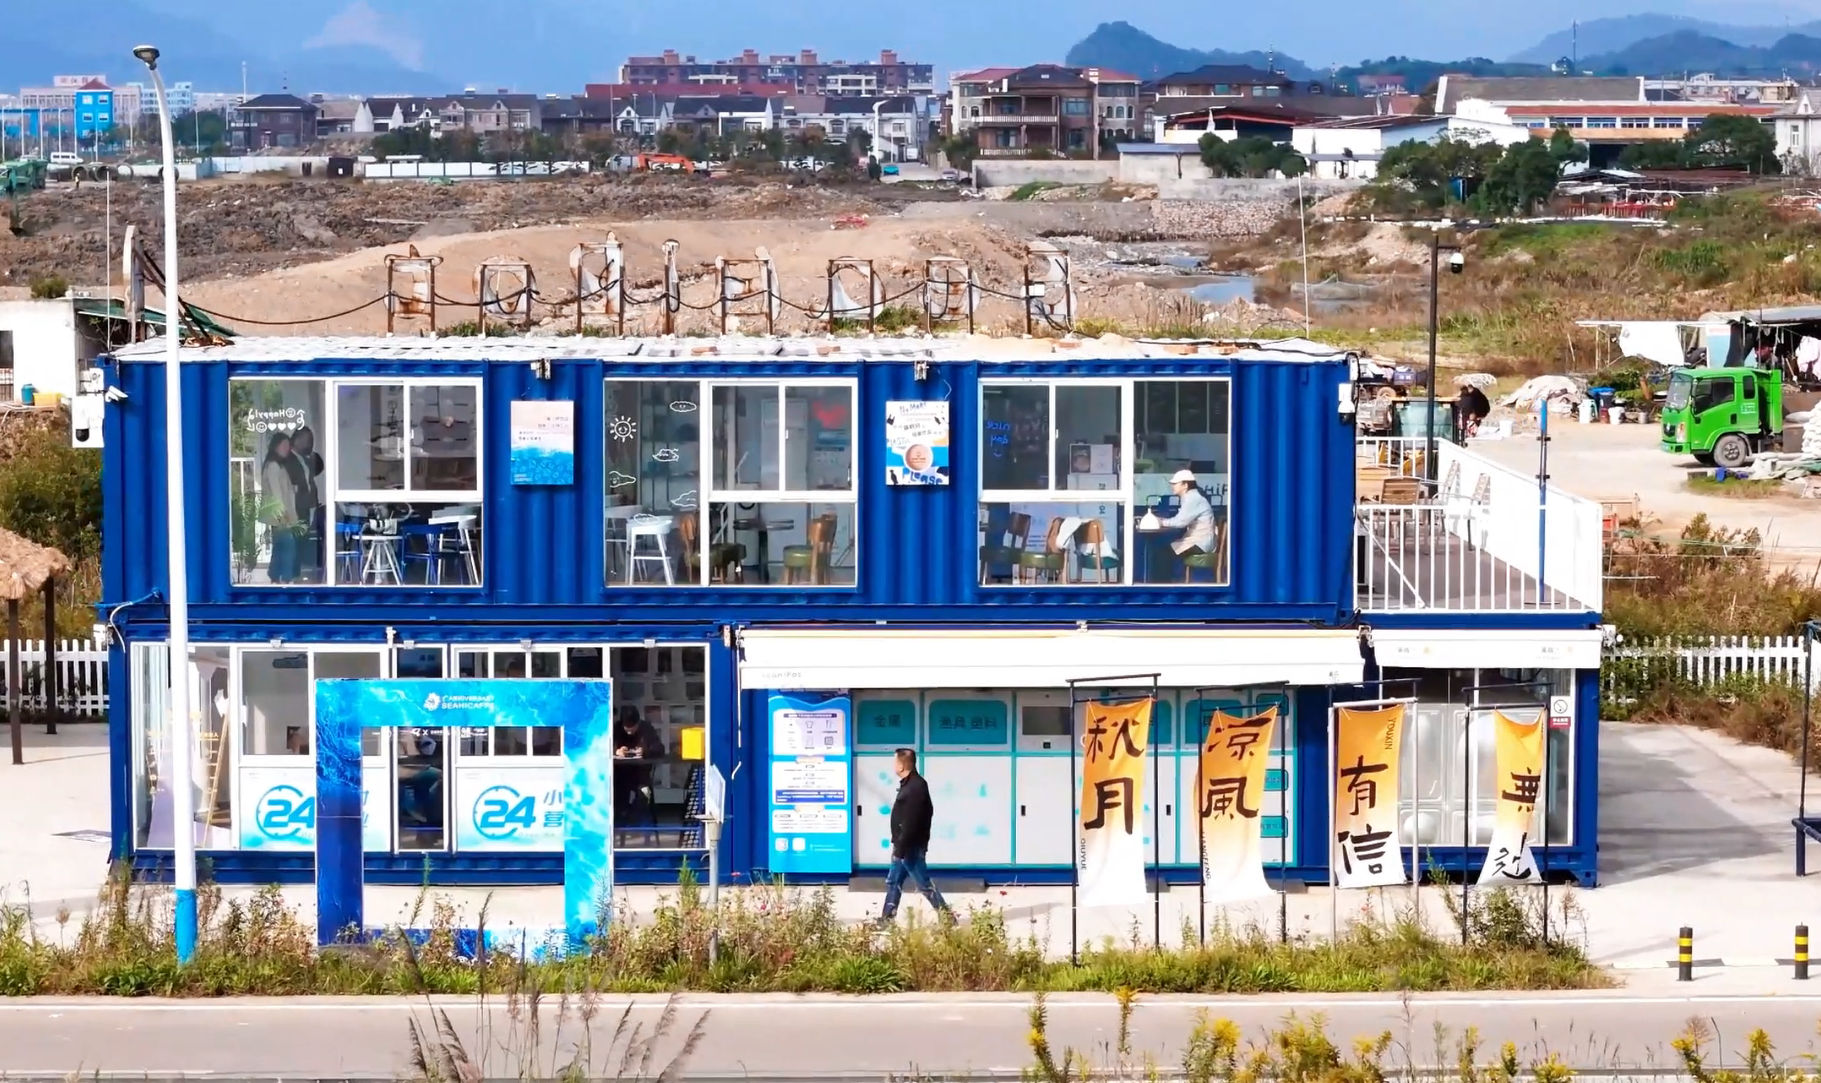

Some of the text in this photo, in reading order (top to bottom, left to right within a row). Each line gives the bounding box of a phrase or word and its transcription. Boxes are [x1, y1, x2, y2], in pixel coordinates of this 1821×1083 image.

[1385, 717, 1397, 750] YOUXIN
[480, 796, 536, 828] 24
[1083, 716, 1145, 835] 秋月
[1337, 755, 1393, 875] 有信
